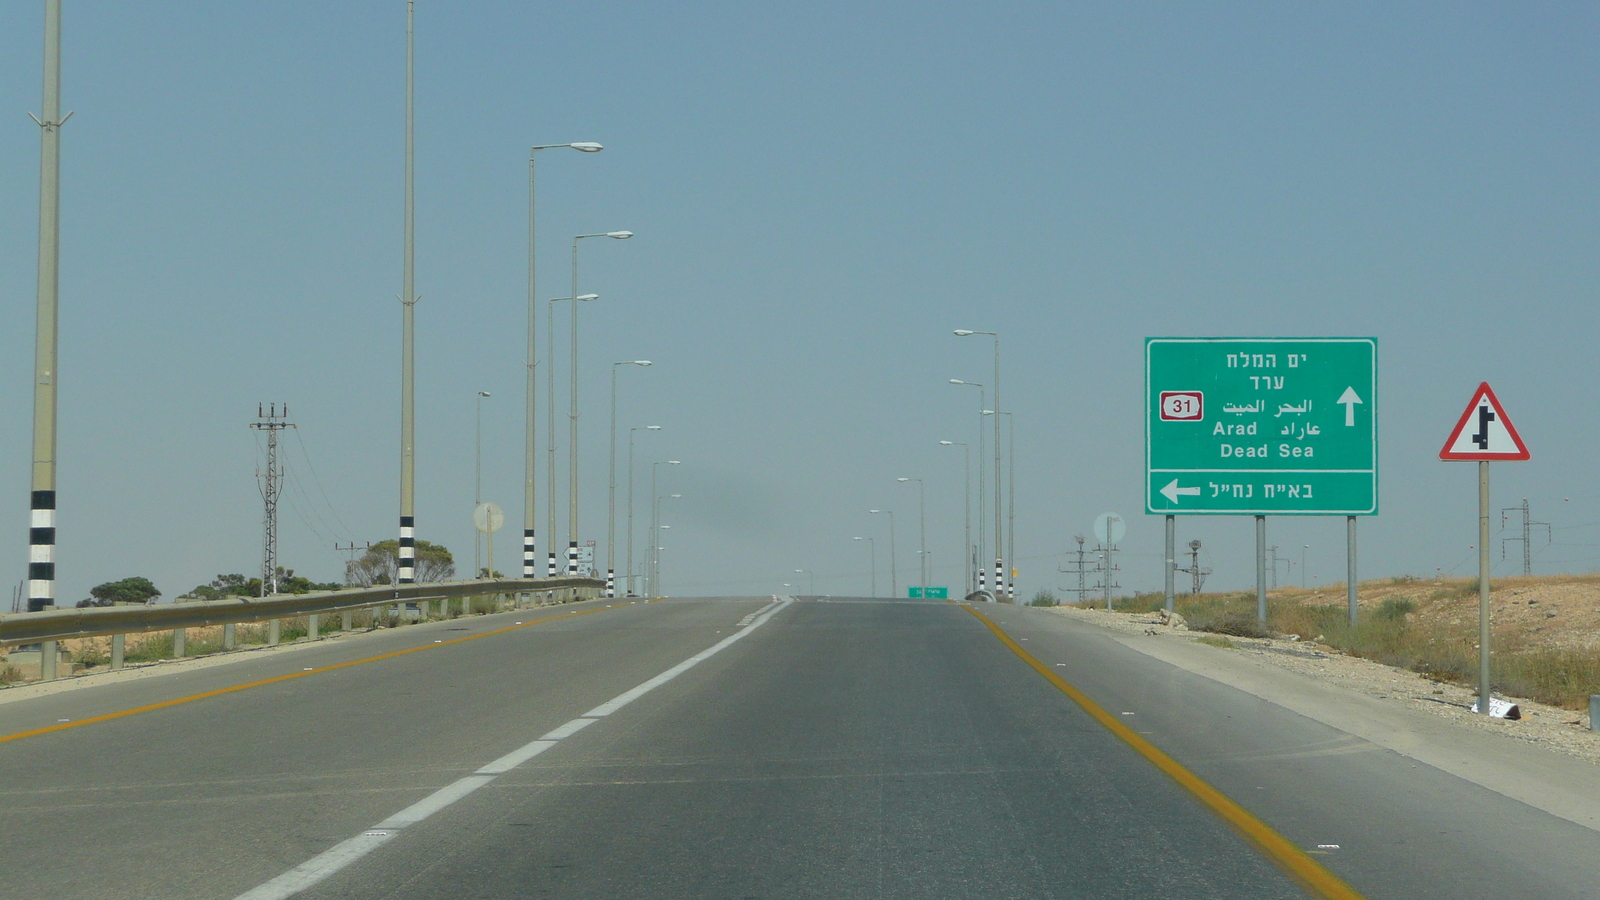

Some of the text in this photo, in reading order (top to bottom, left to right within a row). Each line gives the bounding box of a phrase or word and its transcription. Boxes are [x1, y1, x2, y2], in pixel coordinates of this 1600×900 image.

[1226, 352, 1307, 368] ים המלח
[1250, 376, 1284, 390] ערד
[1172, 399, 1192, 413] 31
[1223, 399, 1312, 418] البحر الميت
[1213, 422, 1257, 436] Arad
[1281, 423, 1321, 440] عاراد
[1220, 444, 1314, 458] Dead Sea
